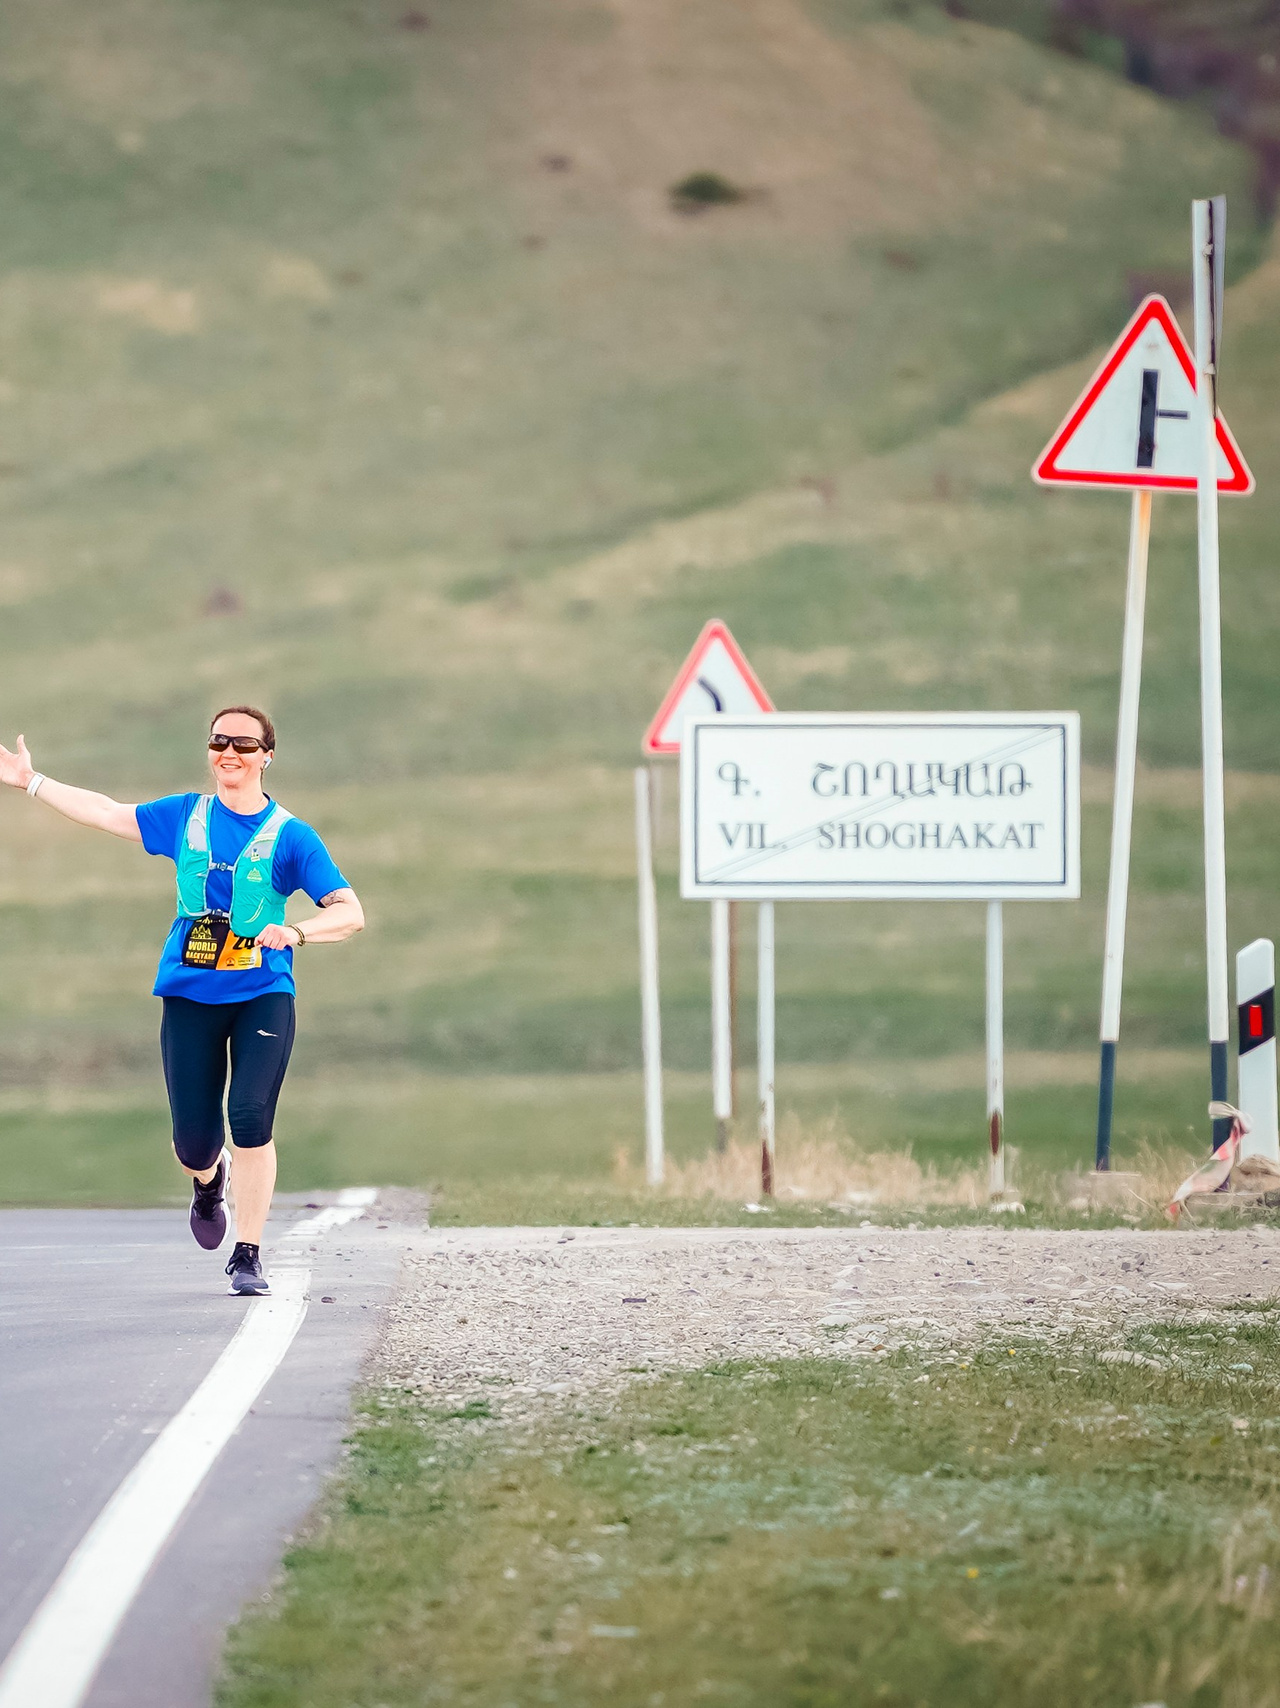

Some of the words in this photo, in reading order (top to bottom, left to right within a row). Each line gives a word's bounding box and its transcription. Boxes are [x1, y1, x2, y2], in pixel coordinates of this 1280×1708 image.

[718, 823, 787, 849] VIL.
[819, 822, 1045, 850] SHOGHAKAT
[188, 941, 217, 952] WORLD
